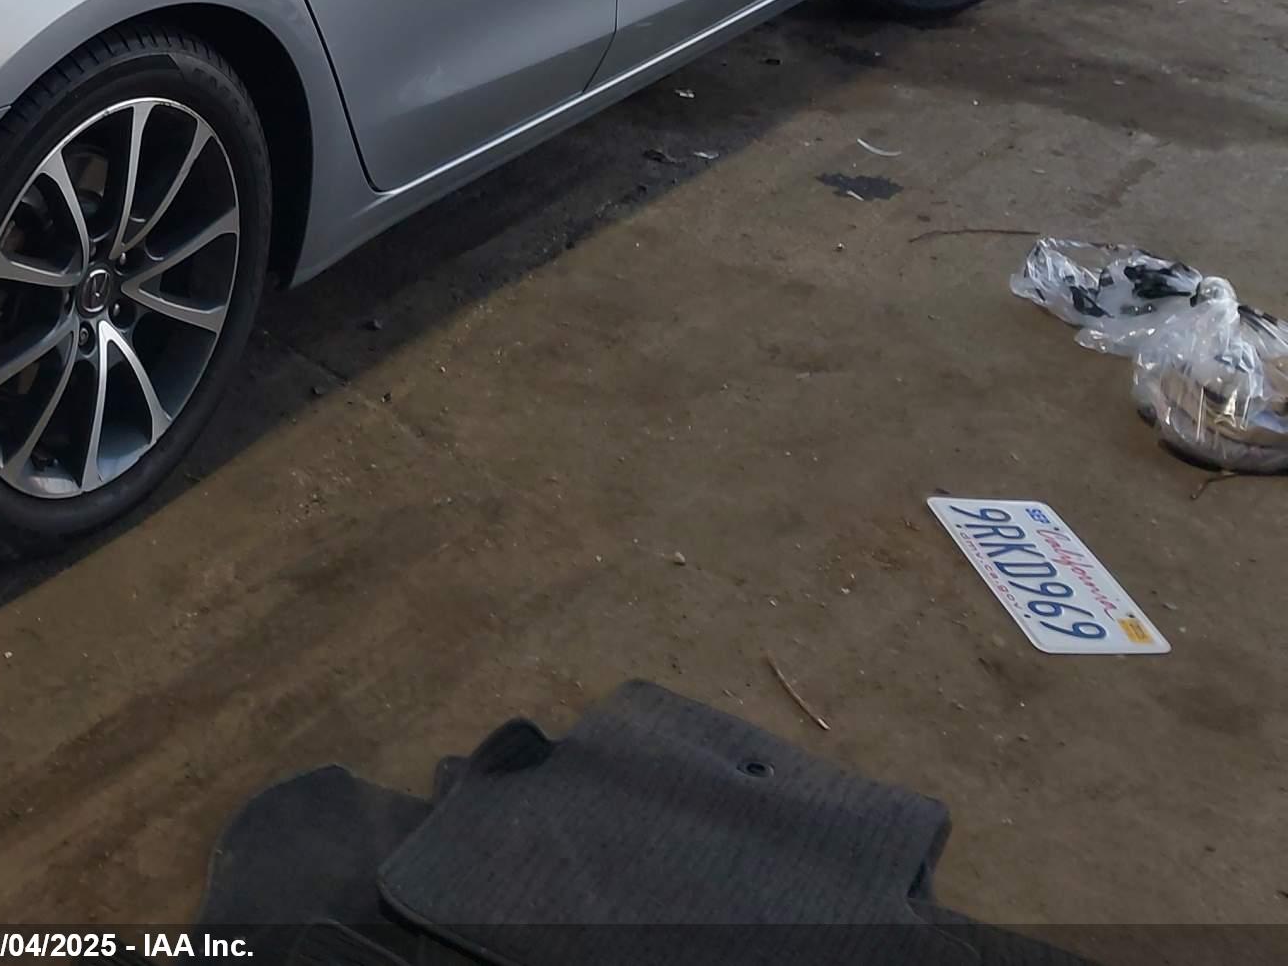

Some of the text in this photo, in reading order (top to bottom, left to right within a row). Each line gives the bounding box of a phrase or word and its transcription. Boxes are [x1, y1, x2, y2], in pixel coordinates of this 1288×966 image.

[1024, 507, 1051, 524] SEP
[949, 504, 1107, 640] 9RKD969
[959, 531, 1024, 611] dmv.ca.gov
[1035, 528, 1115, 622] California
